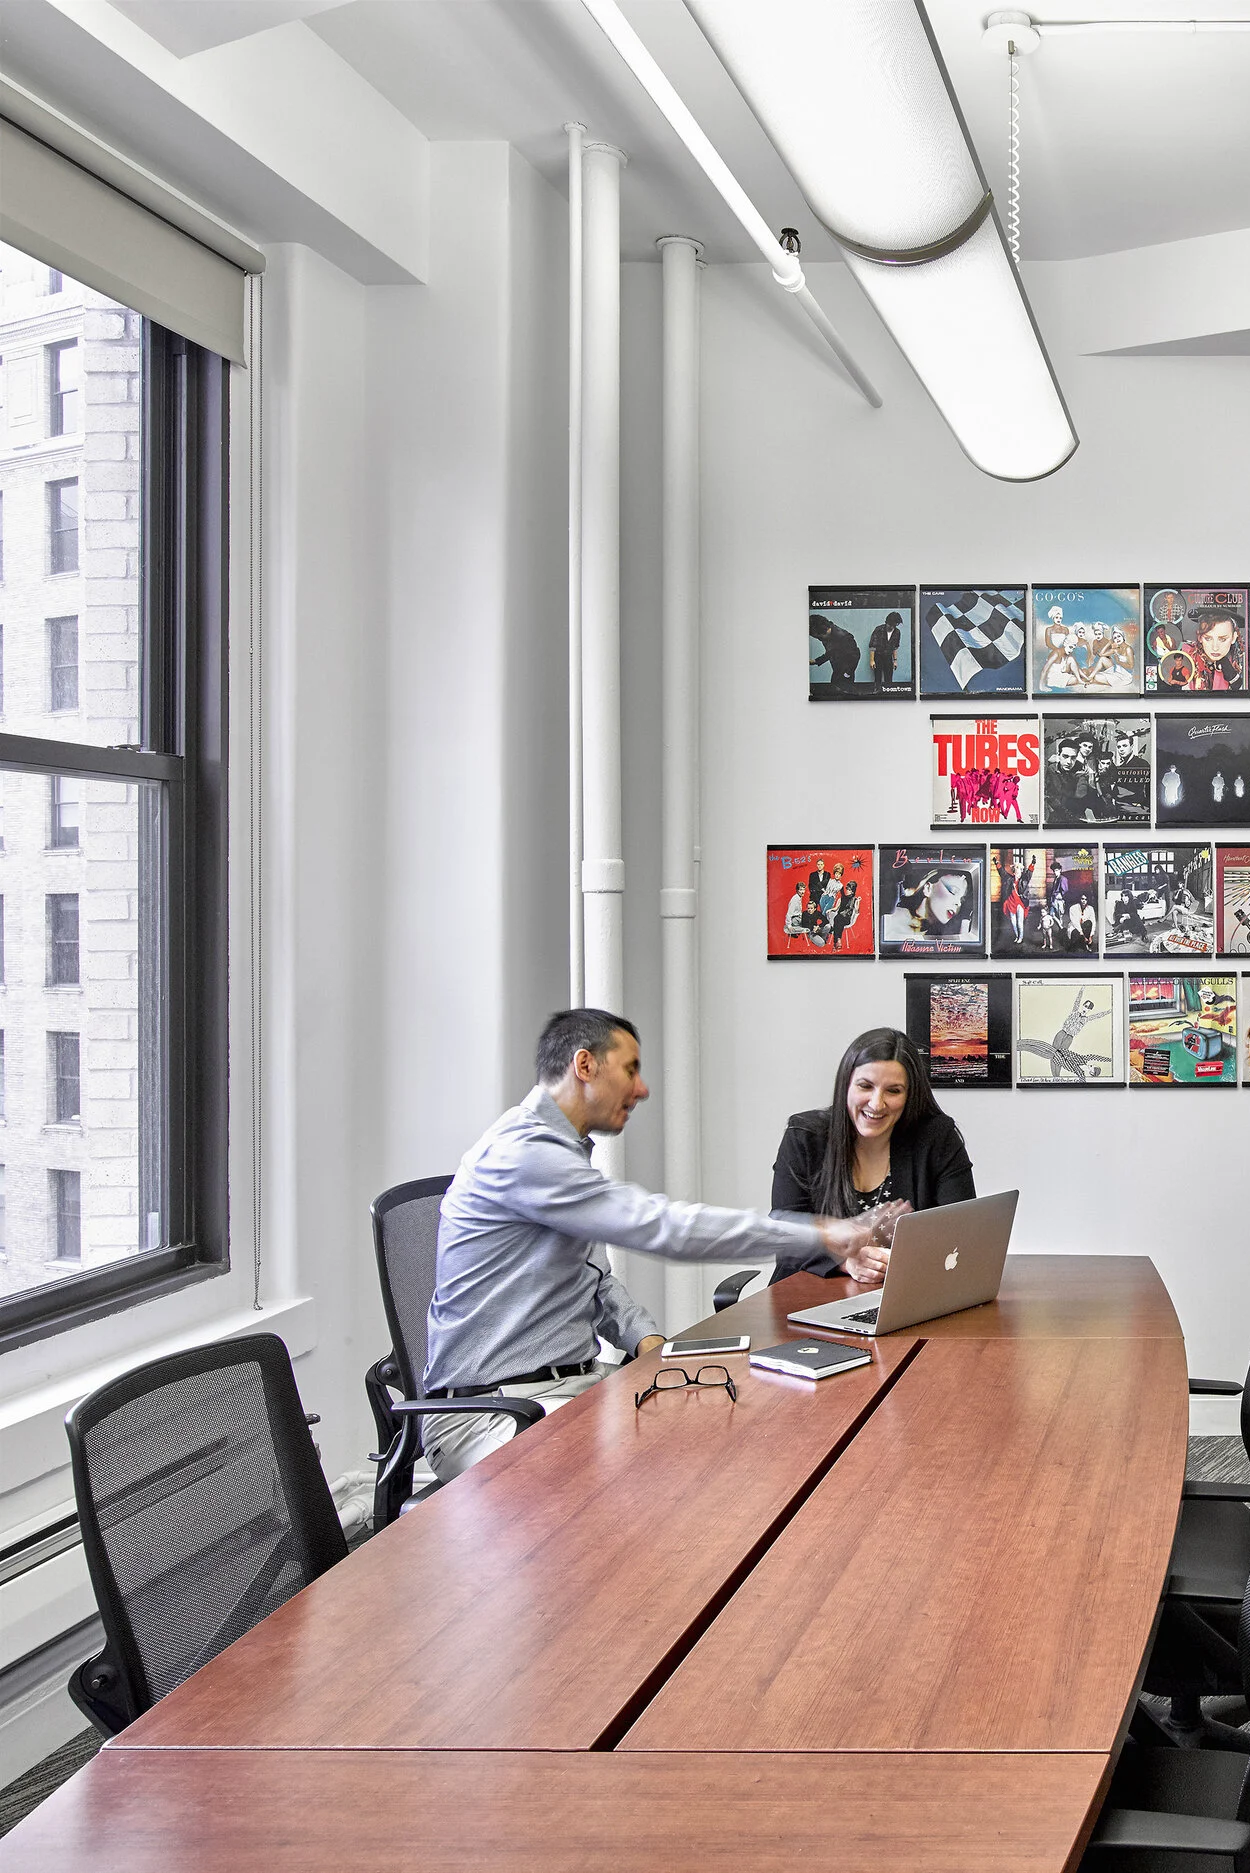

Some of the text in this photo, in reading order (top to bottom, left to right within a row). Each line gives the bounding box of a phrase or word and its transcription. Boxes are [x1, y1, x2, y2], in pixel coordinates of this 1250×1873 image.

[1215, 593, 1244, 604] CLUB
[975, 719, 998, 735] THE
[933, 733, 1040, 777] TUBES
[971, 807, 1001, 823] NOW
[1109, 851, 1147, 876] BANGLES
